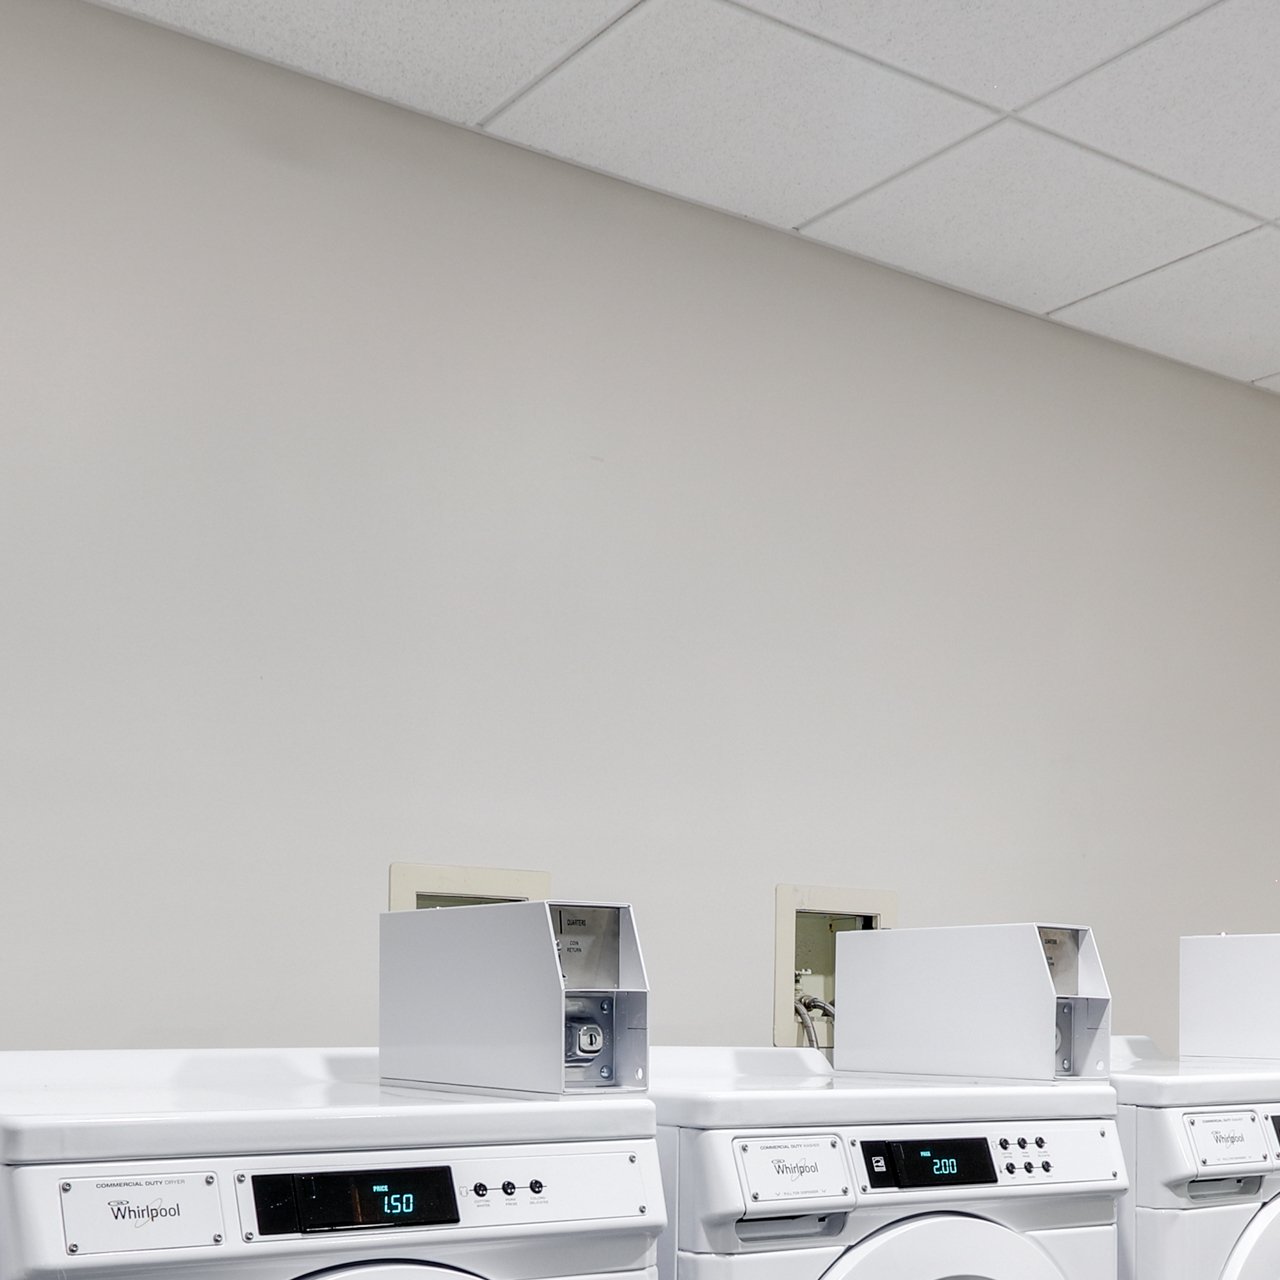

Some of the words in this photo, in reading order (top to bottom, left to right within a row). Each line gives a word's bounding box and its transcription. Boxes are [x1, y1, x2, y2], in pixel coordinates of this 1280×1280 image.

[774, 1162, 819, 1176] Whirlpool
[933, 1159, 957, 1174] 2.00
[384, 1193, 414, 1213] 1.50
[111, 1203, 181, 1222] Whirlpool
